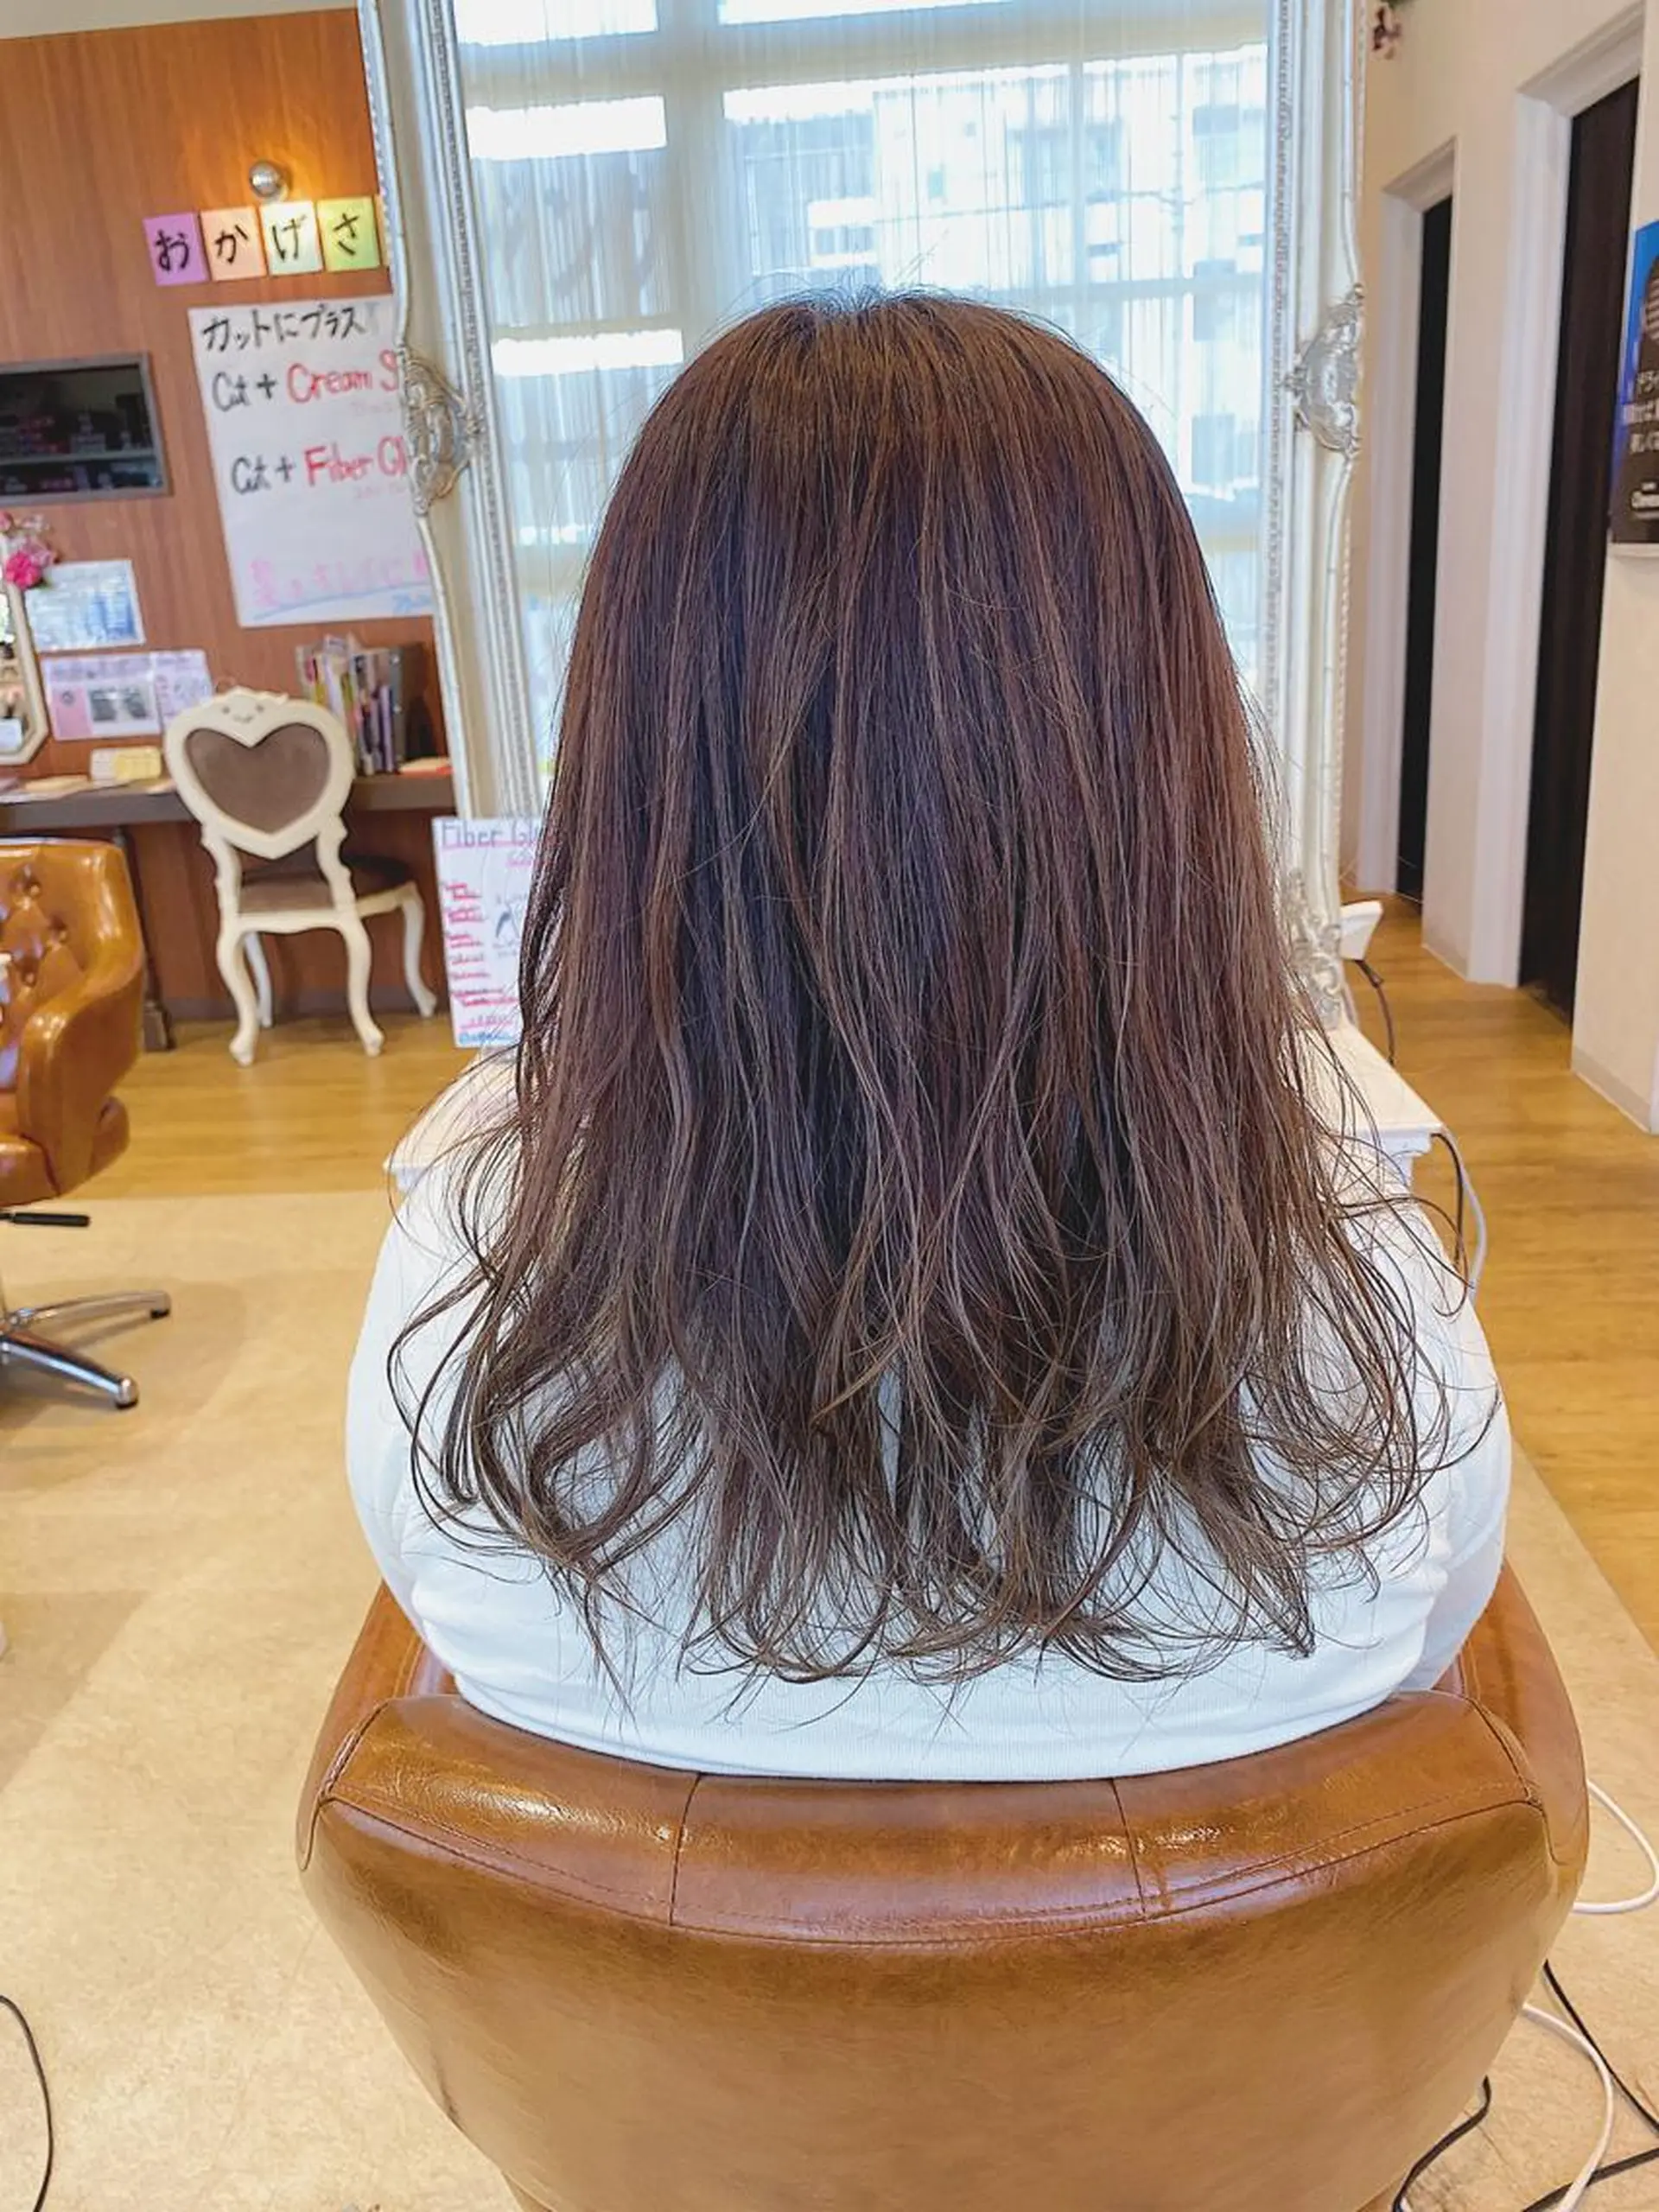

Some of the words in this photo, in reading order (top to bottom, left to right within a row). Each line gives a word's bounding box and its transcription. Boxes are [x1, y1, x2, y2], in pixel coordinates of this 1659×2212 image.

[155, 213, 359, 272] おかげさ
[202, 305, 365, 352] カットにプラス
[213, 372, 251, 412] Cut
[257, 373, 276, 399] +
[287, 363, 372, 404] Cream
[231, 456, 270, 495] Cut
